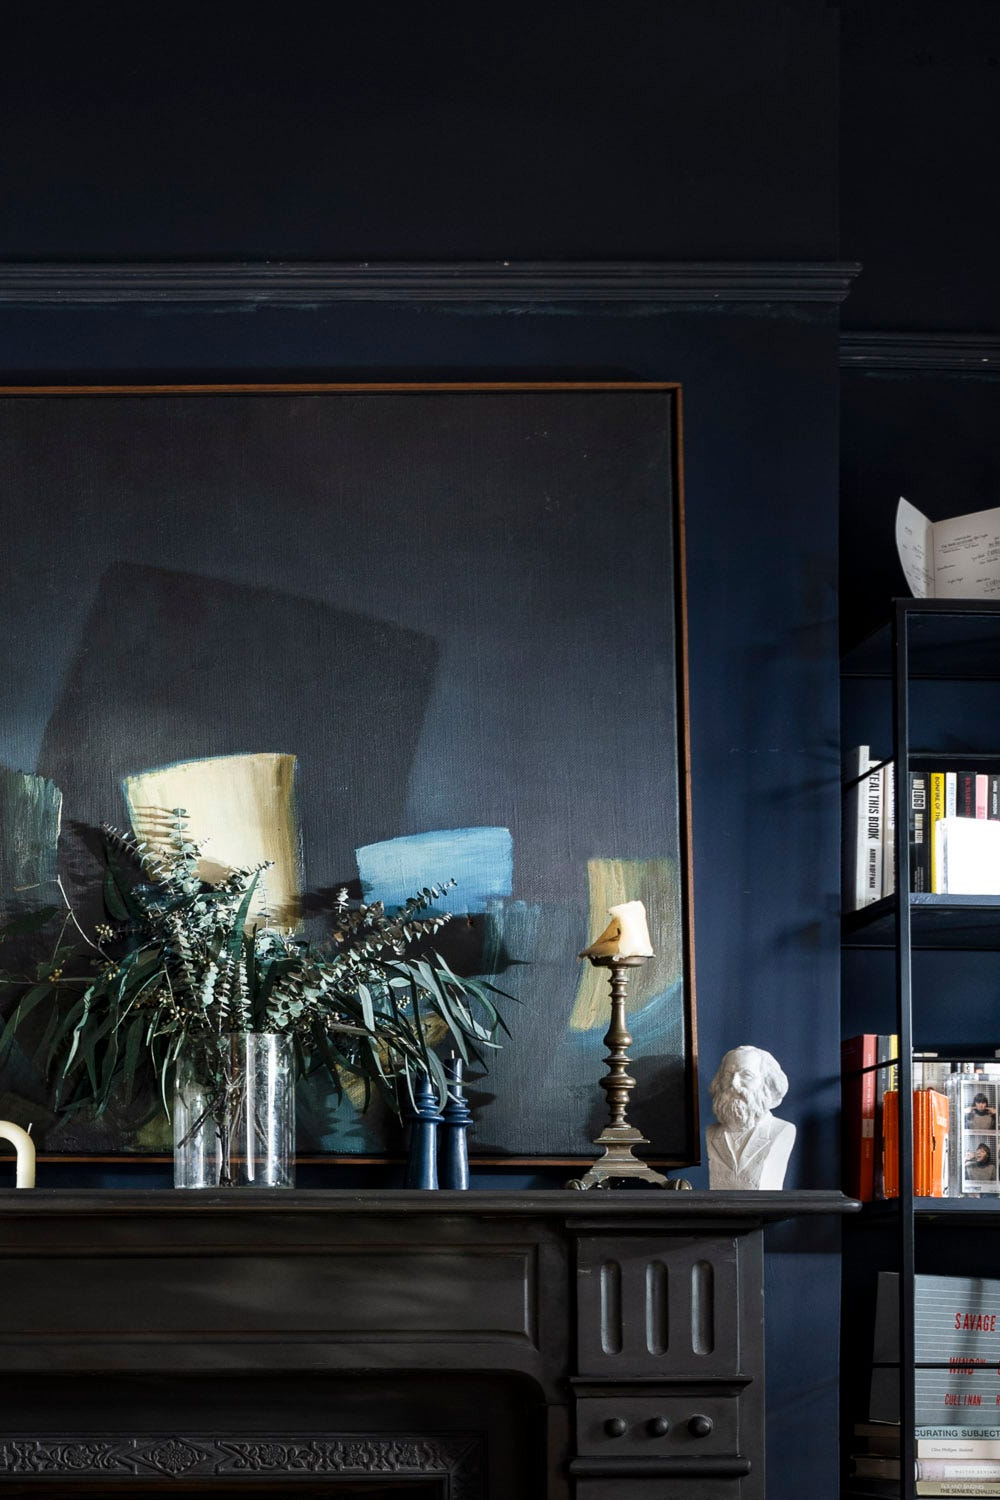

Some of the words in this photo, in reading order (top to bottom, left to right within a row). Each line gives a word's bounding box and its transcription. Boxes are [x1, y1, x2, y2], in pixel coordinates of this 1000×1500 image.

[868, 768, 881, 793] TEAL
[912, 779, 925, 789] NO
[868, 795, 880, 814] THIS
[912, 790, 925, 809] LOGO
[935, 803, 941, 812] OF
[868, 817, 880, 840] BOOK
[955, 1312, 997, 1332] SAVAGE
